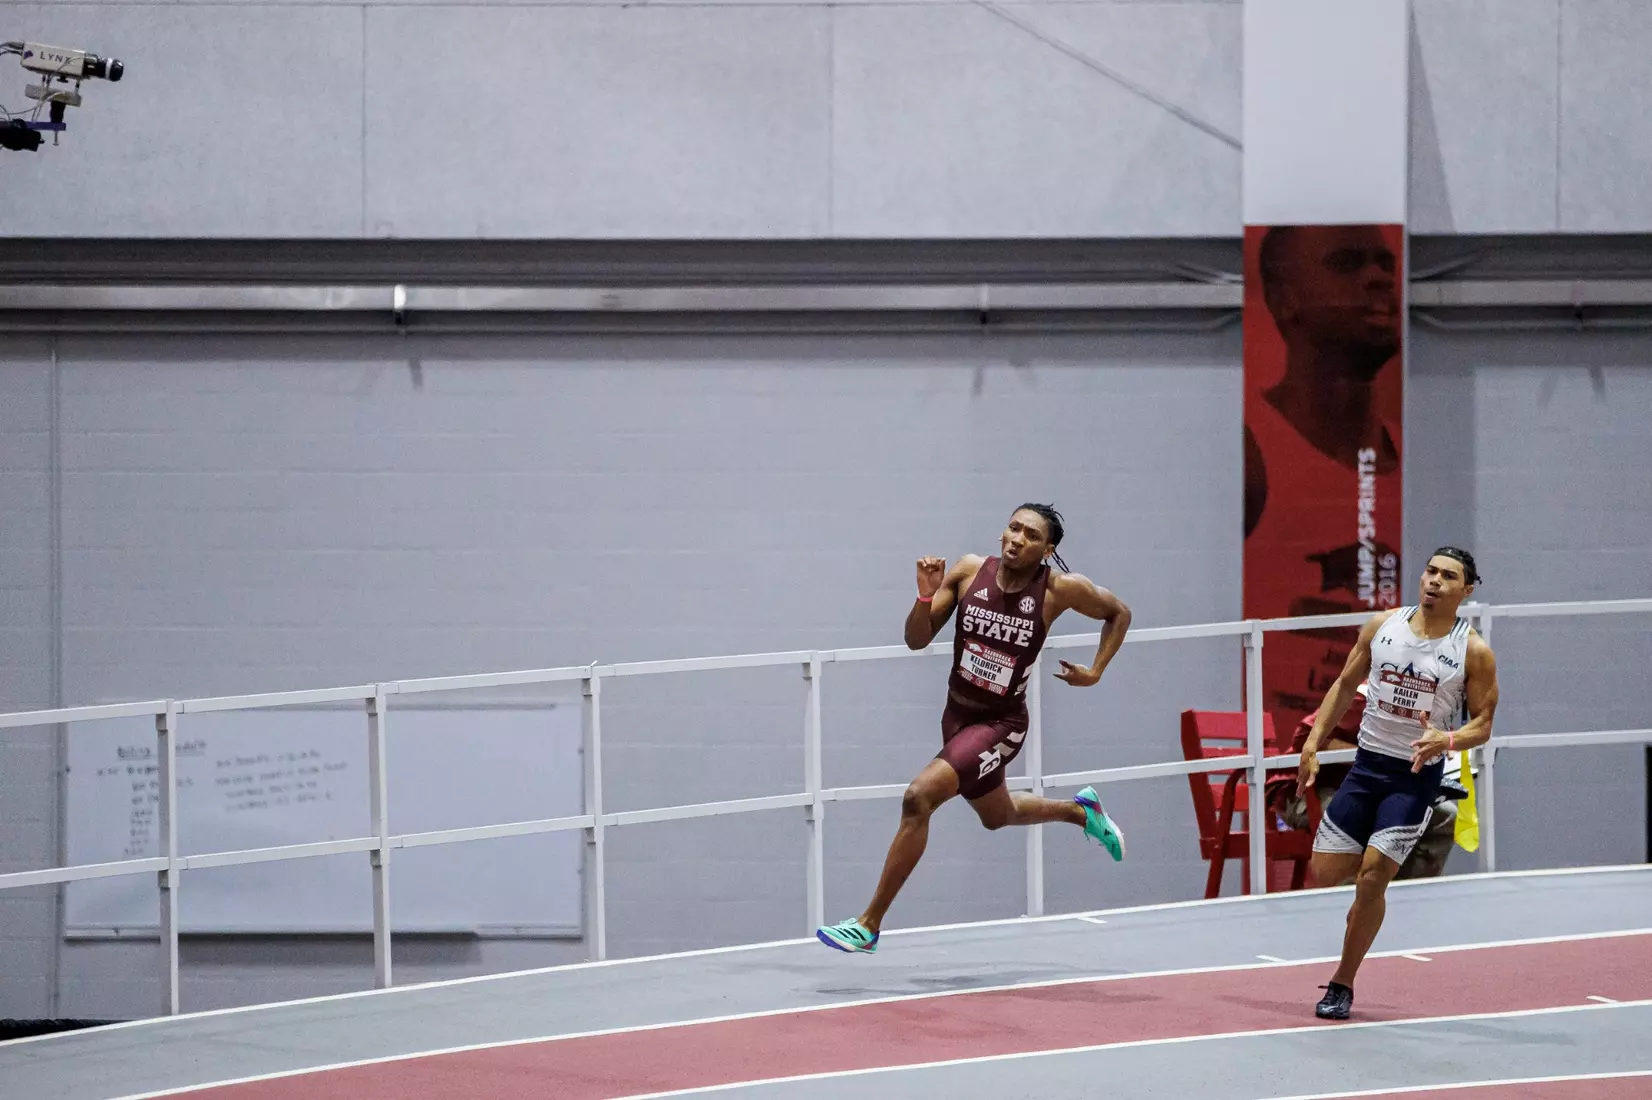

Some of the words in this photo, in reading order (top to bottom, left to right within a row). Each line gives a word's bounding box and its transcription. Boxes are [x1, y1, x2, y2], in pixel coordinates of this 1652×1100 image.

[40, 51, 72, 64] LYNX
[1357, 447, 1377, 608] JUMP/SPRINTS
[1378, 552, 1397, 606] 2016
[1020, 597, 1034, 613] SEC
[965, 604, 1034, 631] MISSISSIPPI
[962, 615, 1034, 648] STATE
[970, 654, 1003, 674] KELDRICK
[1438, 654, 1459, 670] CIAA
[971, 664, 997, 682] TURNER
[1392, 696, 1417, 708] PERRY
[1393, 687, 1419, 699] KAILEN
